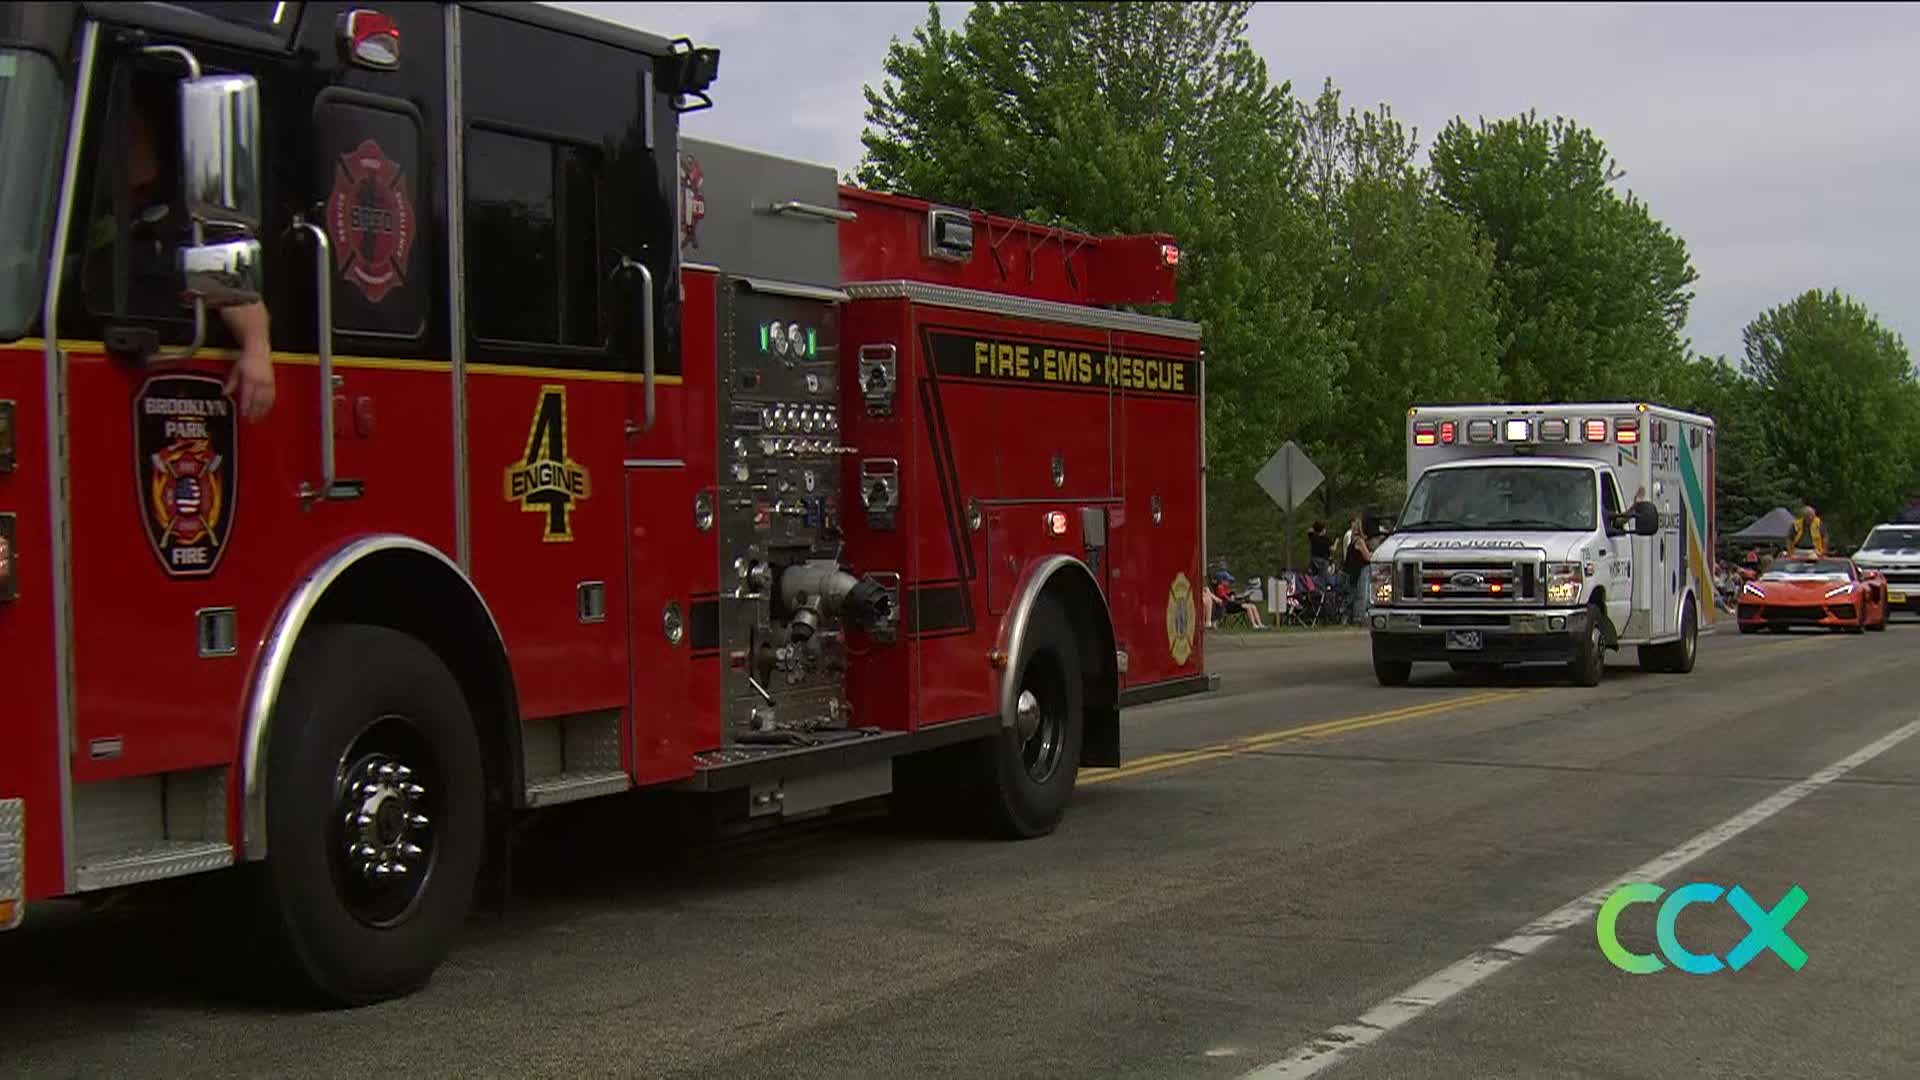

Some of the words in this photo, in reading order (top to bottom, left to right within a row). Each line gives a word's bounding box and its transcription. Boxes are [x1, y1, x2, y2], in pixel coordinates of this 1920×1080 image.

[974, 341, 1031, 378] FIRE
[1043, 349, 1092, 384] EMS
[1104, 355, 1185, 391] RESCUE
[145, 398, 227, 416] BROOKLYN
[165, 421, 208, 438] PARK
[522, 386, 574, 540] 4
[511, 463, 584, 498] ENGINE
[172, 547, 208, 565] FIRE
